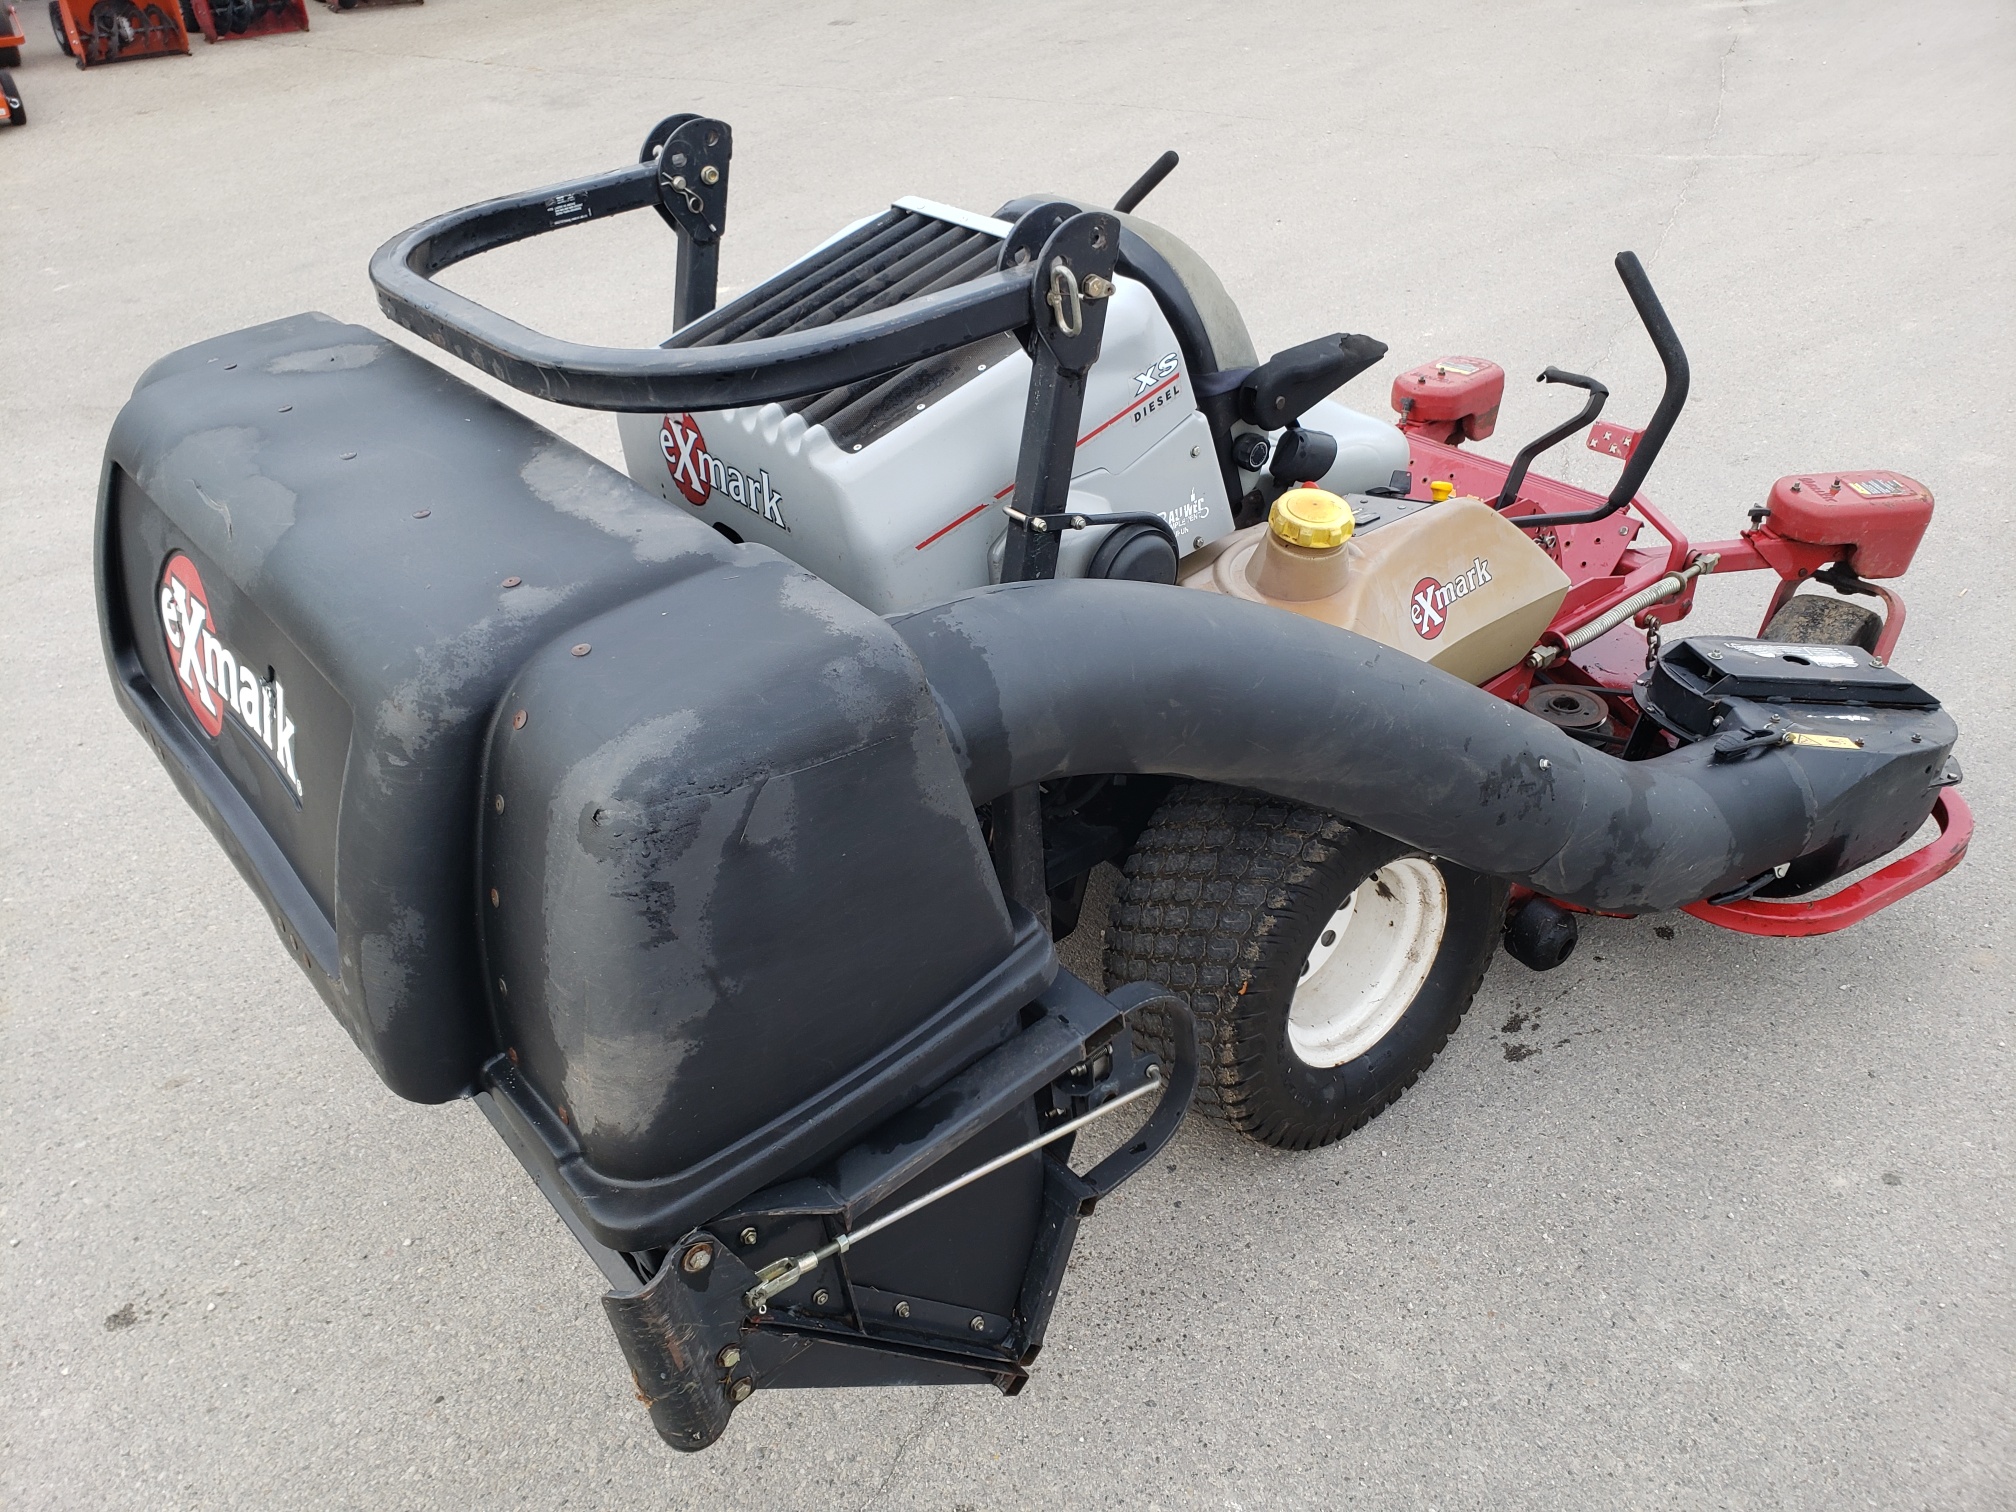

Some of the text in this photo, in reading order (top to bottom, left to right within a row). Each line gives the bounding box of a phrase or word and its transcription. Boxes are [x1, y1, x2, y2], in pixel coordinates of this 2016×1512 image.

[1134, 352, 1179, 397] XS
[1134, 385, 1180, 423] DIESEL
[659, 418, 787, 531] eXmark
[1410, 556, 1493, 635] eXmark
